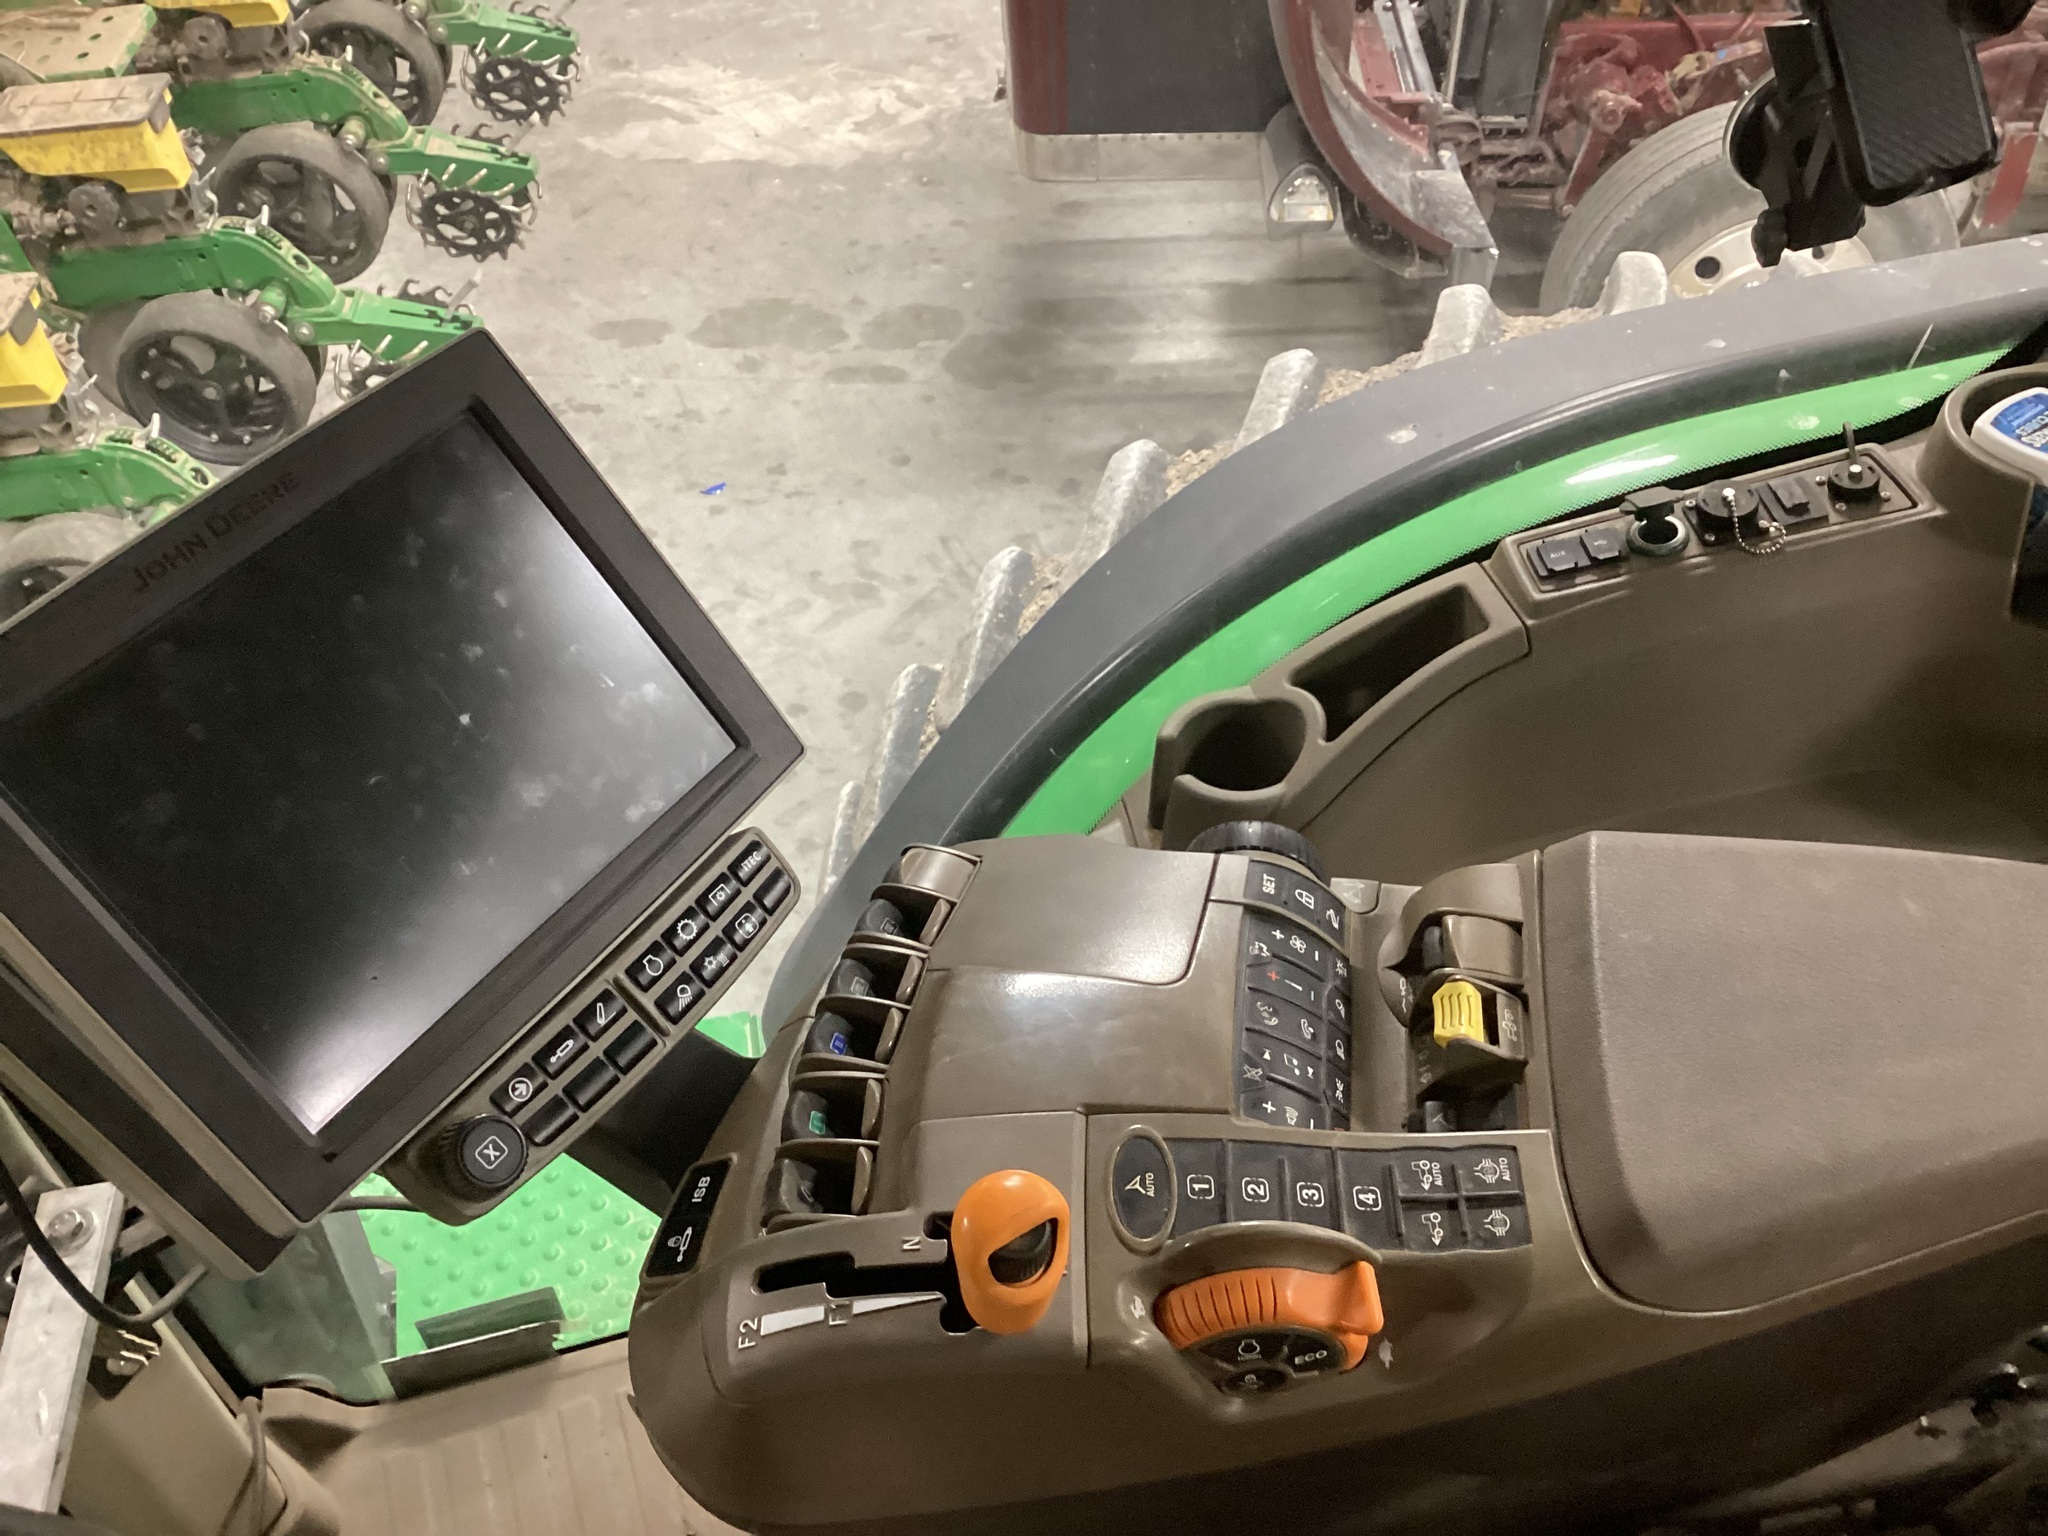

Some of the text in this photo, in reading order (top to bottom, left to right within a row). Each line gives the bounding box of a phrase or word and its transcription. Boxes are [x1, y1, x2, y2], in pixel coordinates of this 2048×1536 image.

[1550, 550, 1566, 558] AUX
[741, 849, 763, 873] ITEC
[1262, 873, 1275, 895] SET
[1431, 1162, 1443, 1186] AUTO
[1499, 1157, 1512, 1181] AUTO
[691, 1176, 711, 1203] ISB
[1145, 1172, 1155, 1197] AUTO
[1192, 1180, 1209, 1193] 1
[1247, 1183, 1264, 1197] 2
[1302, 1187, 1320, 1202] 3
[1358, 1191, 1377, 1205] 4
[903, 1236, 922, 1252] N
[738, 1317, 760, 1350] F2
[1294, 1349, 1328, 1365] ECO
